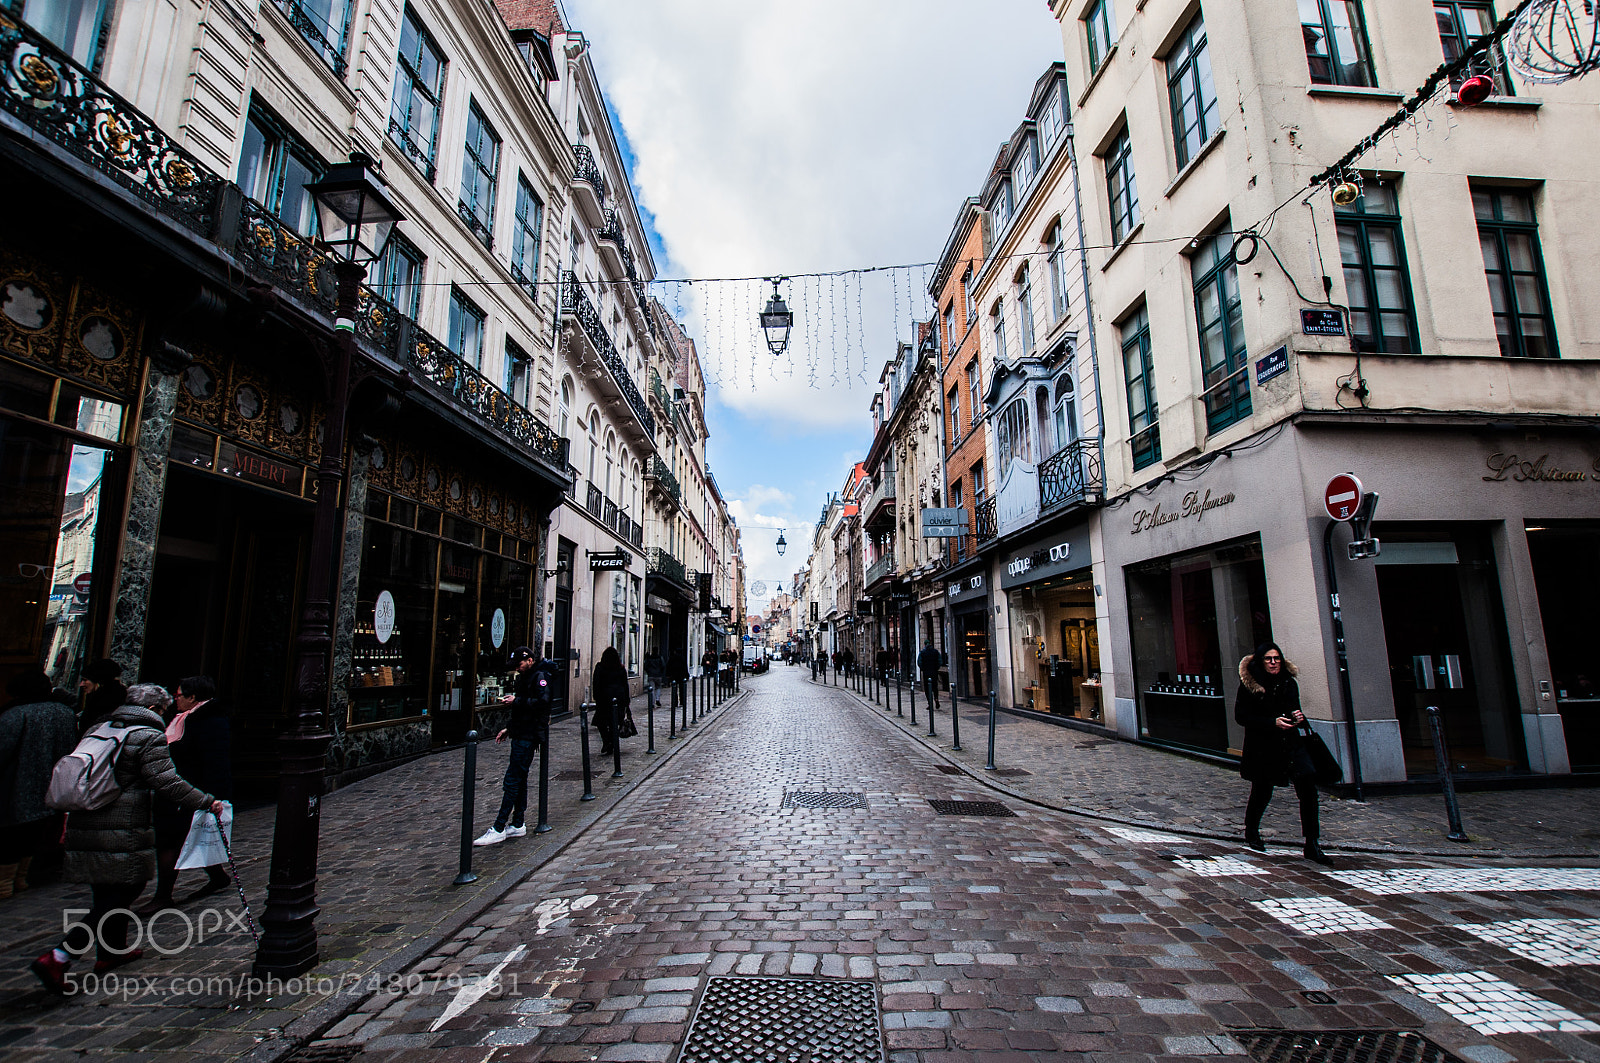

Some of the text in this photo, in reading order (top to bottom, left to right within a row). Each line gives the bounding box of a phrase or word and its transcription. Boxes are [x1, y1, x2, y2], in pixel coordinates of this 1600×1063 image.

[1270, 355, 1278, 363] Rue
[233, 452, 290, 485] MEERT
[1482, 453, 1586, 482] L'Artisan
[929, 517, 952, 525] olivier
[1131, 488, 1236, 535] L'Artisan Parfumeur
